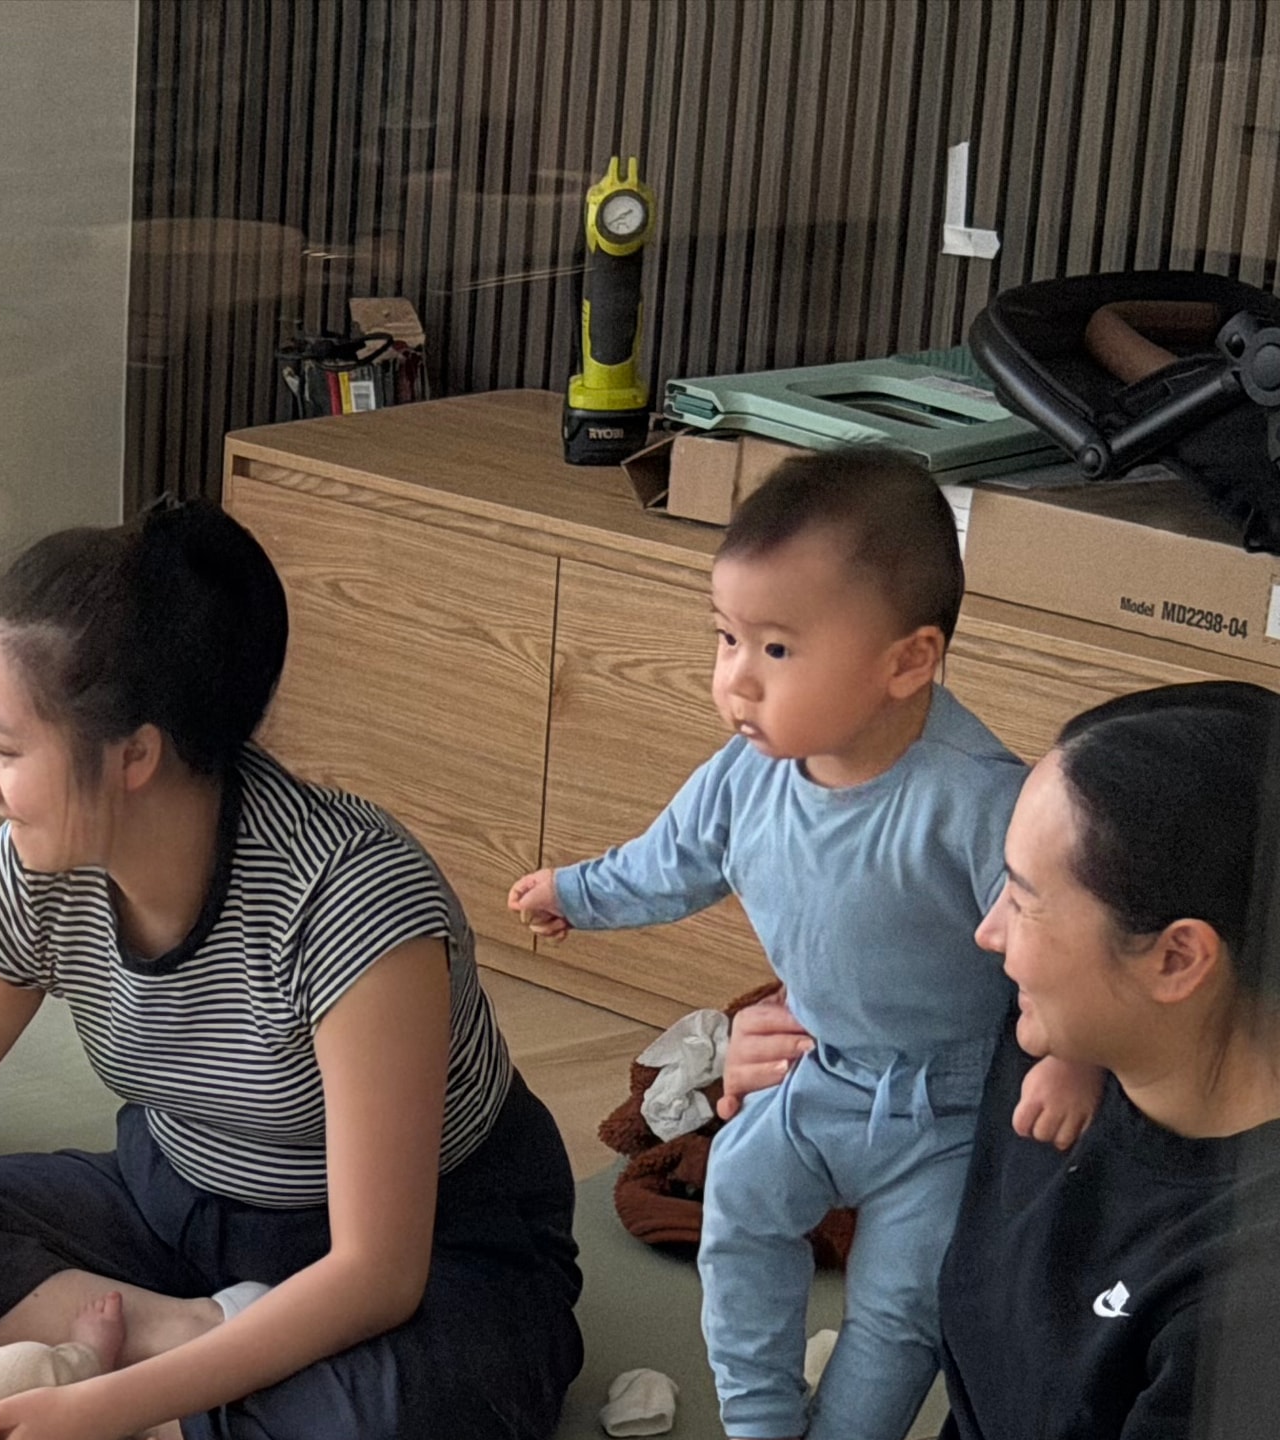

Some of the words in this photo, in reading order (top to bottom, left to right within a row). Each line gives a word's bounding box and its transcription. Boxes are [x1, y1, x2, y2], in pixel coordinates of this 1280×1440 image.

[588, 427, 624, 440] RYOBI
[1120, 596, 1155, 617] Model
[1161, 600, 1248, 639] MD2298-04
